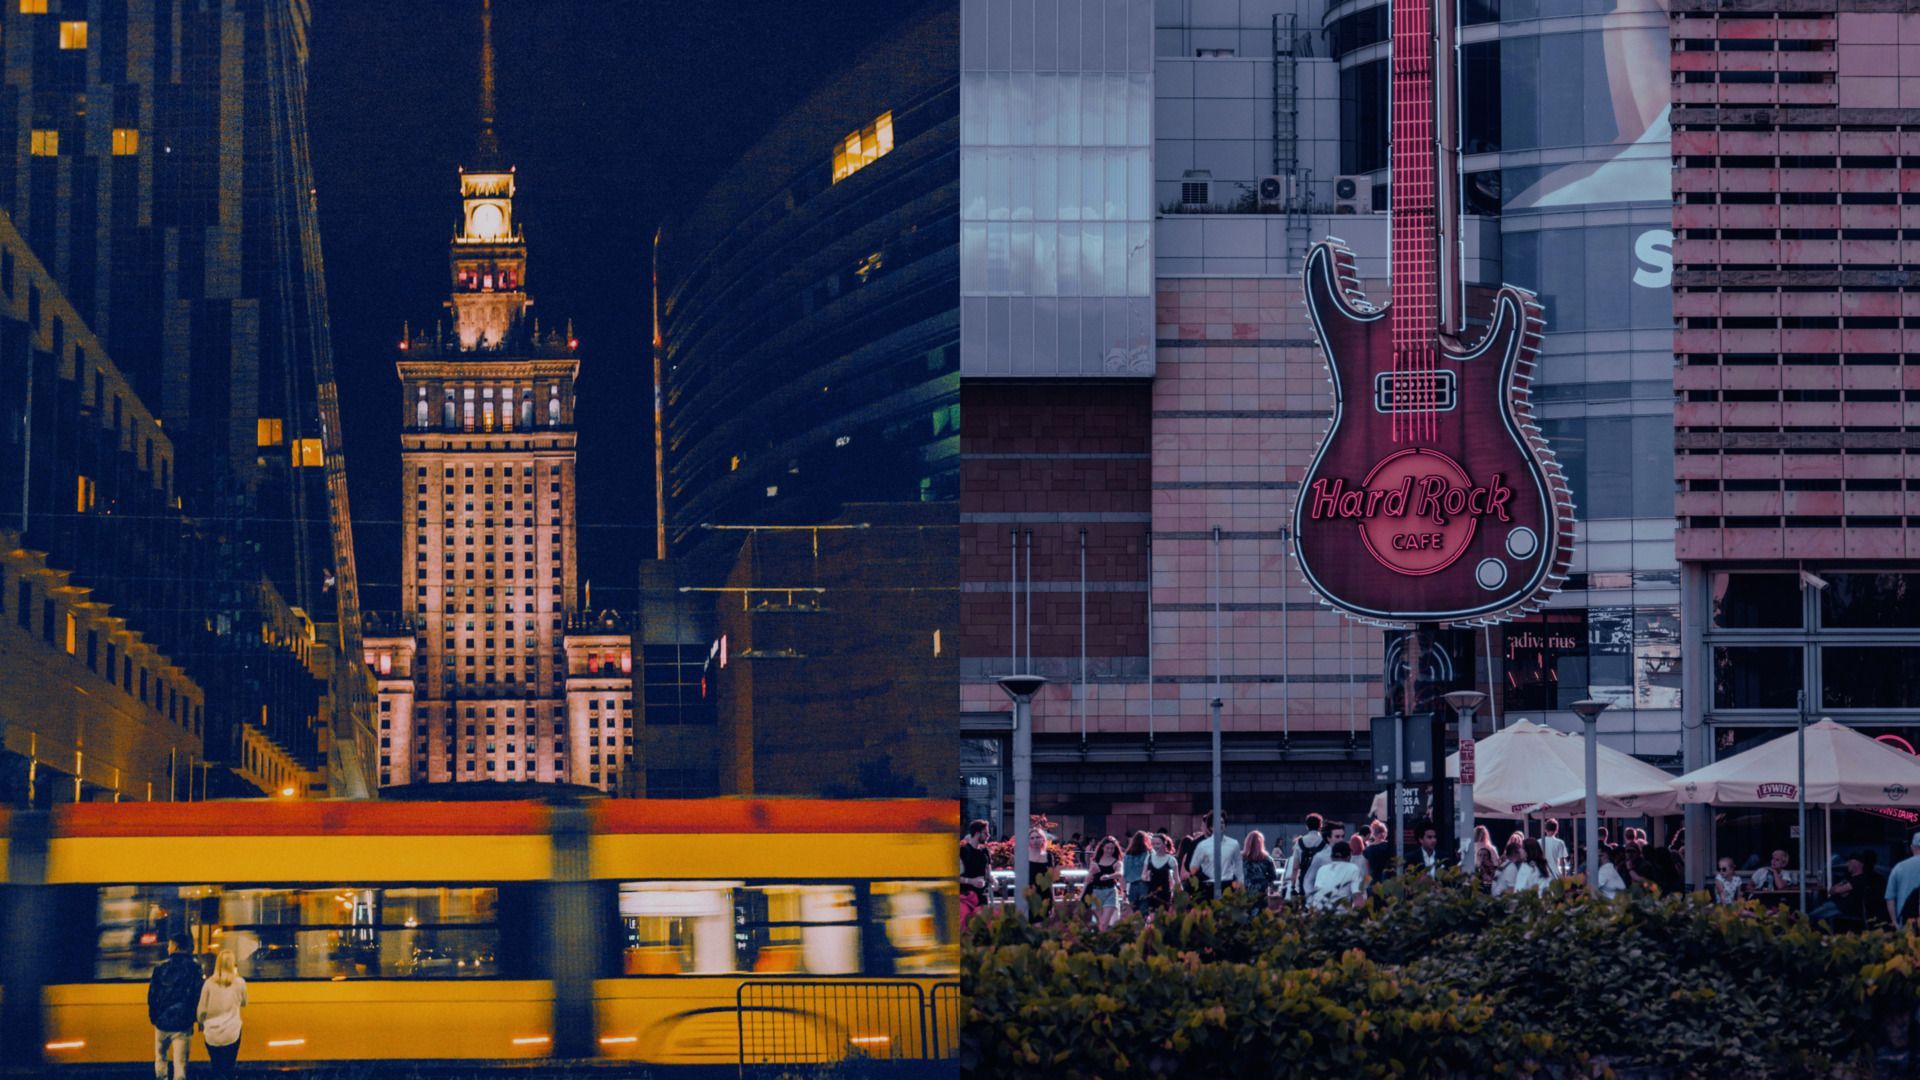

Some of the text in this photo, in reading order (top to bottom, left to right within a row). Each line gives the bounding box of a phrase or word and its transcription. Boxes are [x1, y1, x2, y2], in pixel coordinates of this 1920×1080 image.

[1312, 473, 1512, 525] Hard Rock
[1392, 533, 1444, 550] CAFE
[969, 776, 988, 786] HUB
[1413, 796, 1420, 806] A
